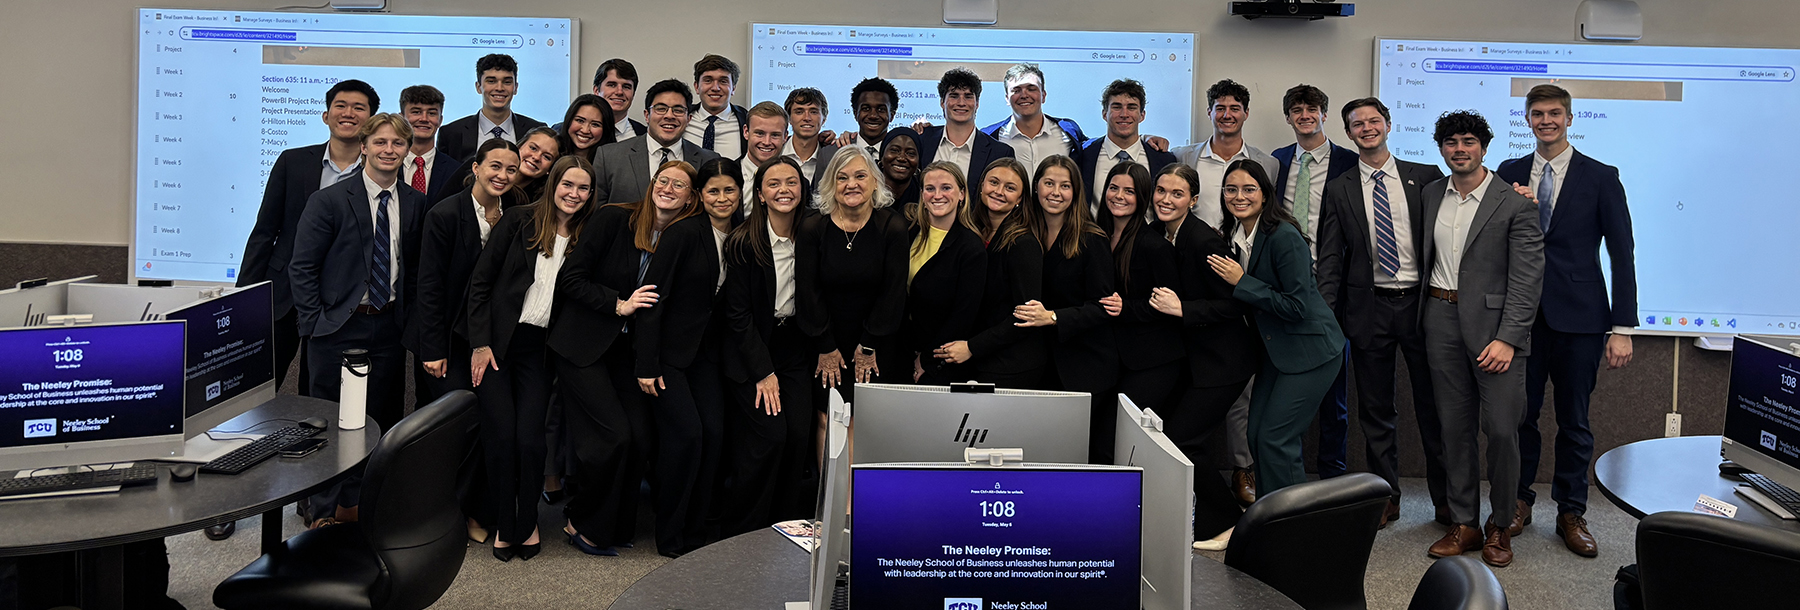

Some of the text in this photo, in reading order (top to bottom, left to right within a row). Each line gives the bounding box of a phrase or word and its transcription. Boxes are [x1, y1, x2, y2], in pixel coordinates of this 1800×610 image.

[288, 97, 309, 105] Project
[262, 107, 283, 115] Project
[1509, 142, 1531, 150] Project
[216, 315, 230, 329] 1:08
[53, 349, 83, 362] 1:08
[22, 379, 112, 391] The Neeley Promise:
[1781, 373, 1797, 388] 1:08
[75, 388, 109, 396] unleashes
[134, 384, 164, 393] potential
[80, 395, 114, 403] innovation
[62, 417, 109, 427] Neeley School
[28, 423, 52, 434] TCU
[1762, 434, 1775, 447] TCU
[980, 501, 1015, 517] 1:08
[942, 545, 1051, 557] The Neeley Promise:
[877, 558, 1115, 569] The Neeley School of Business unleashes human potential
[884, 569, 902, 577] with
[903, 569, 946, 579] leadership
[958, 570, 971, 578] the
[993, 570, 1009, 578] and
[1011, 570, 1054, 578] innovation
[1055, 570, 1063, 578] in
[991, 601, 1047, 610] Neeley School
